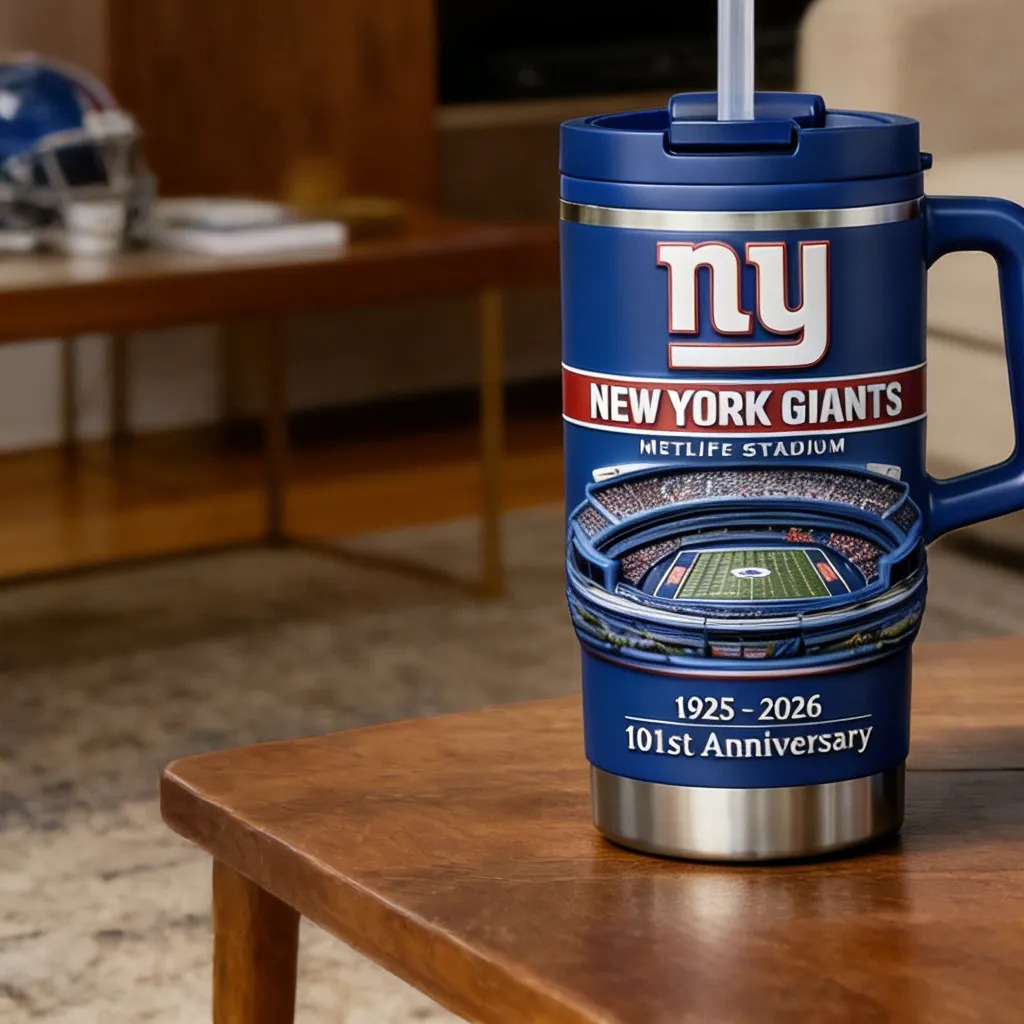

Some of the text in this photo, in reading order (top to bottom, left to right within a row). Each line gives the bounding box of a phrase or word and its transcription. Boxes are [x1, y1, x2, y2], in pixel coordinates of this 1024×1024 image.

[656, 240, 830, 370] ny
[590, 381, 902, 427] NEW YORK GIANTS
[742, 438, 845, 458] STADIUM
[675, 696, 735, 721] 1925
[758, 694, 822, 721] 2026
[625, 725, 874, 758] 101st Anniversary
